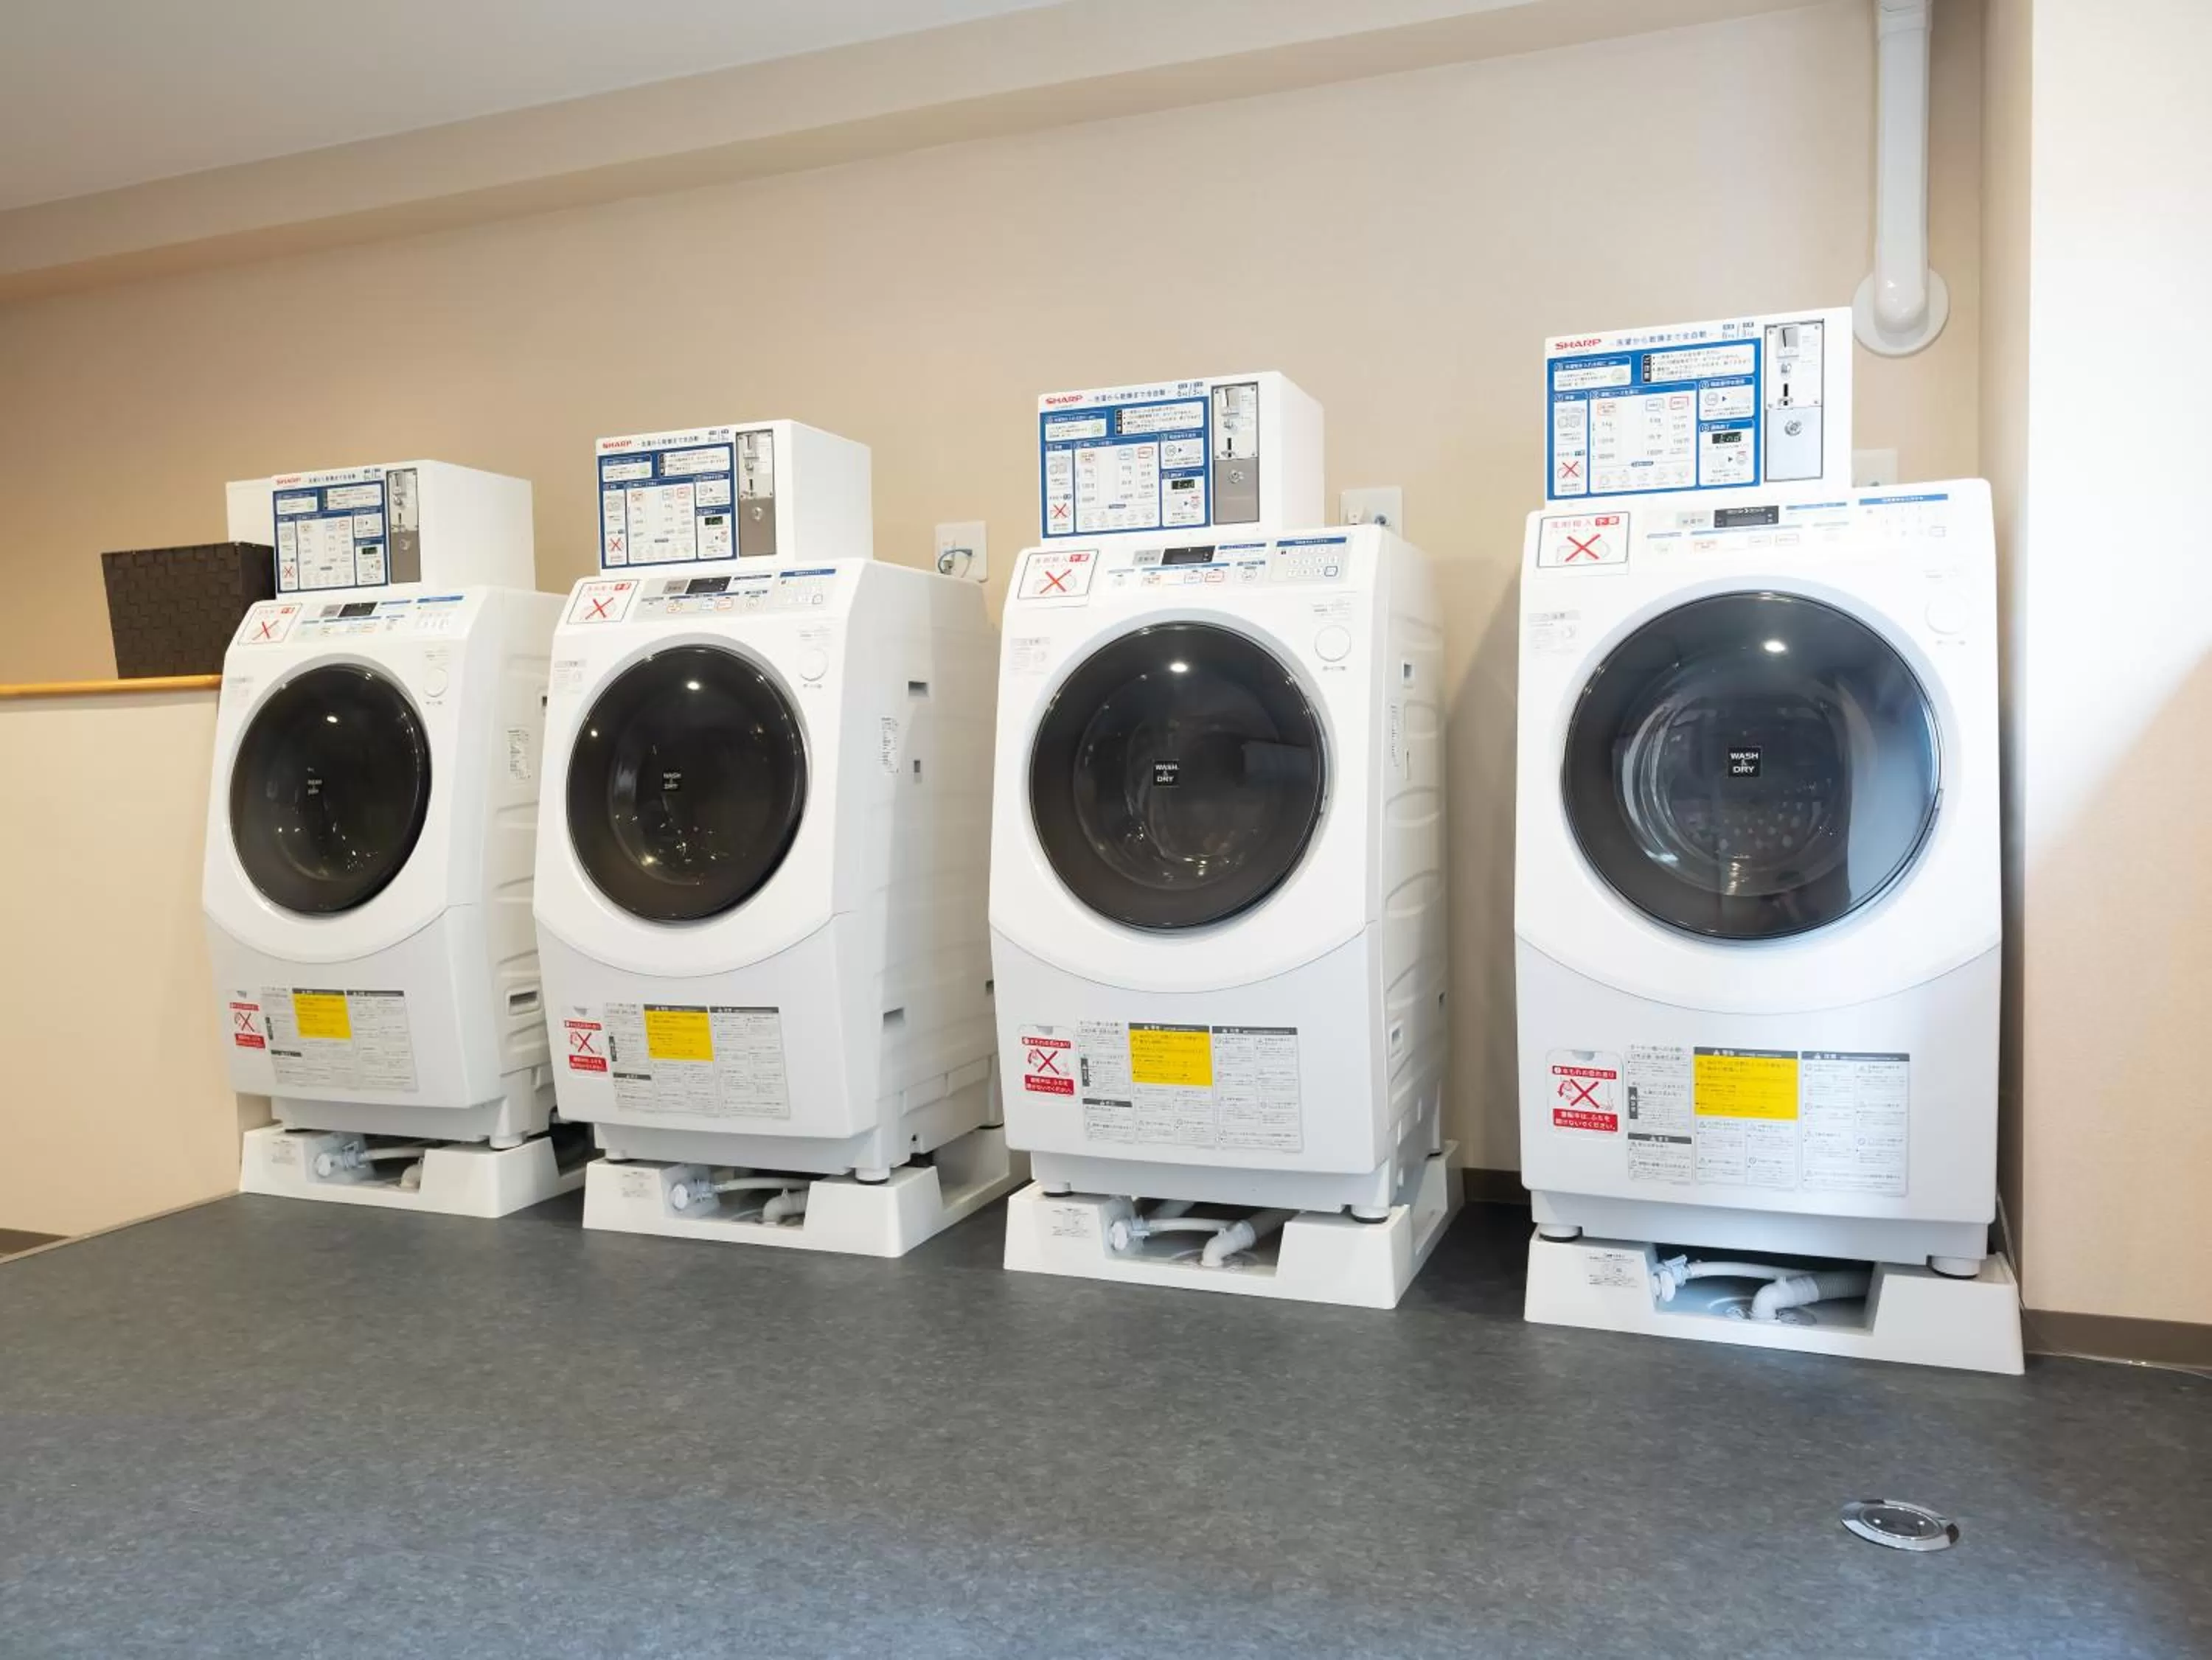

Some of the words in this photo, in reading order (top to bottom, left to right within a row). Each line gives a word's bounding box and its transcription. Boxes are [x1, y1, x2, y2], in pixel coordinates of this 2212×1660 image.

[1555, 338, 1601, 350] SHARP
[1046, 394, 1083, 405] SHARP
[602, 440, 632, 449] SHARP
[1730, 752, 1759, 760] WASH
